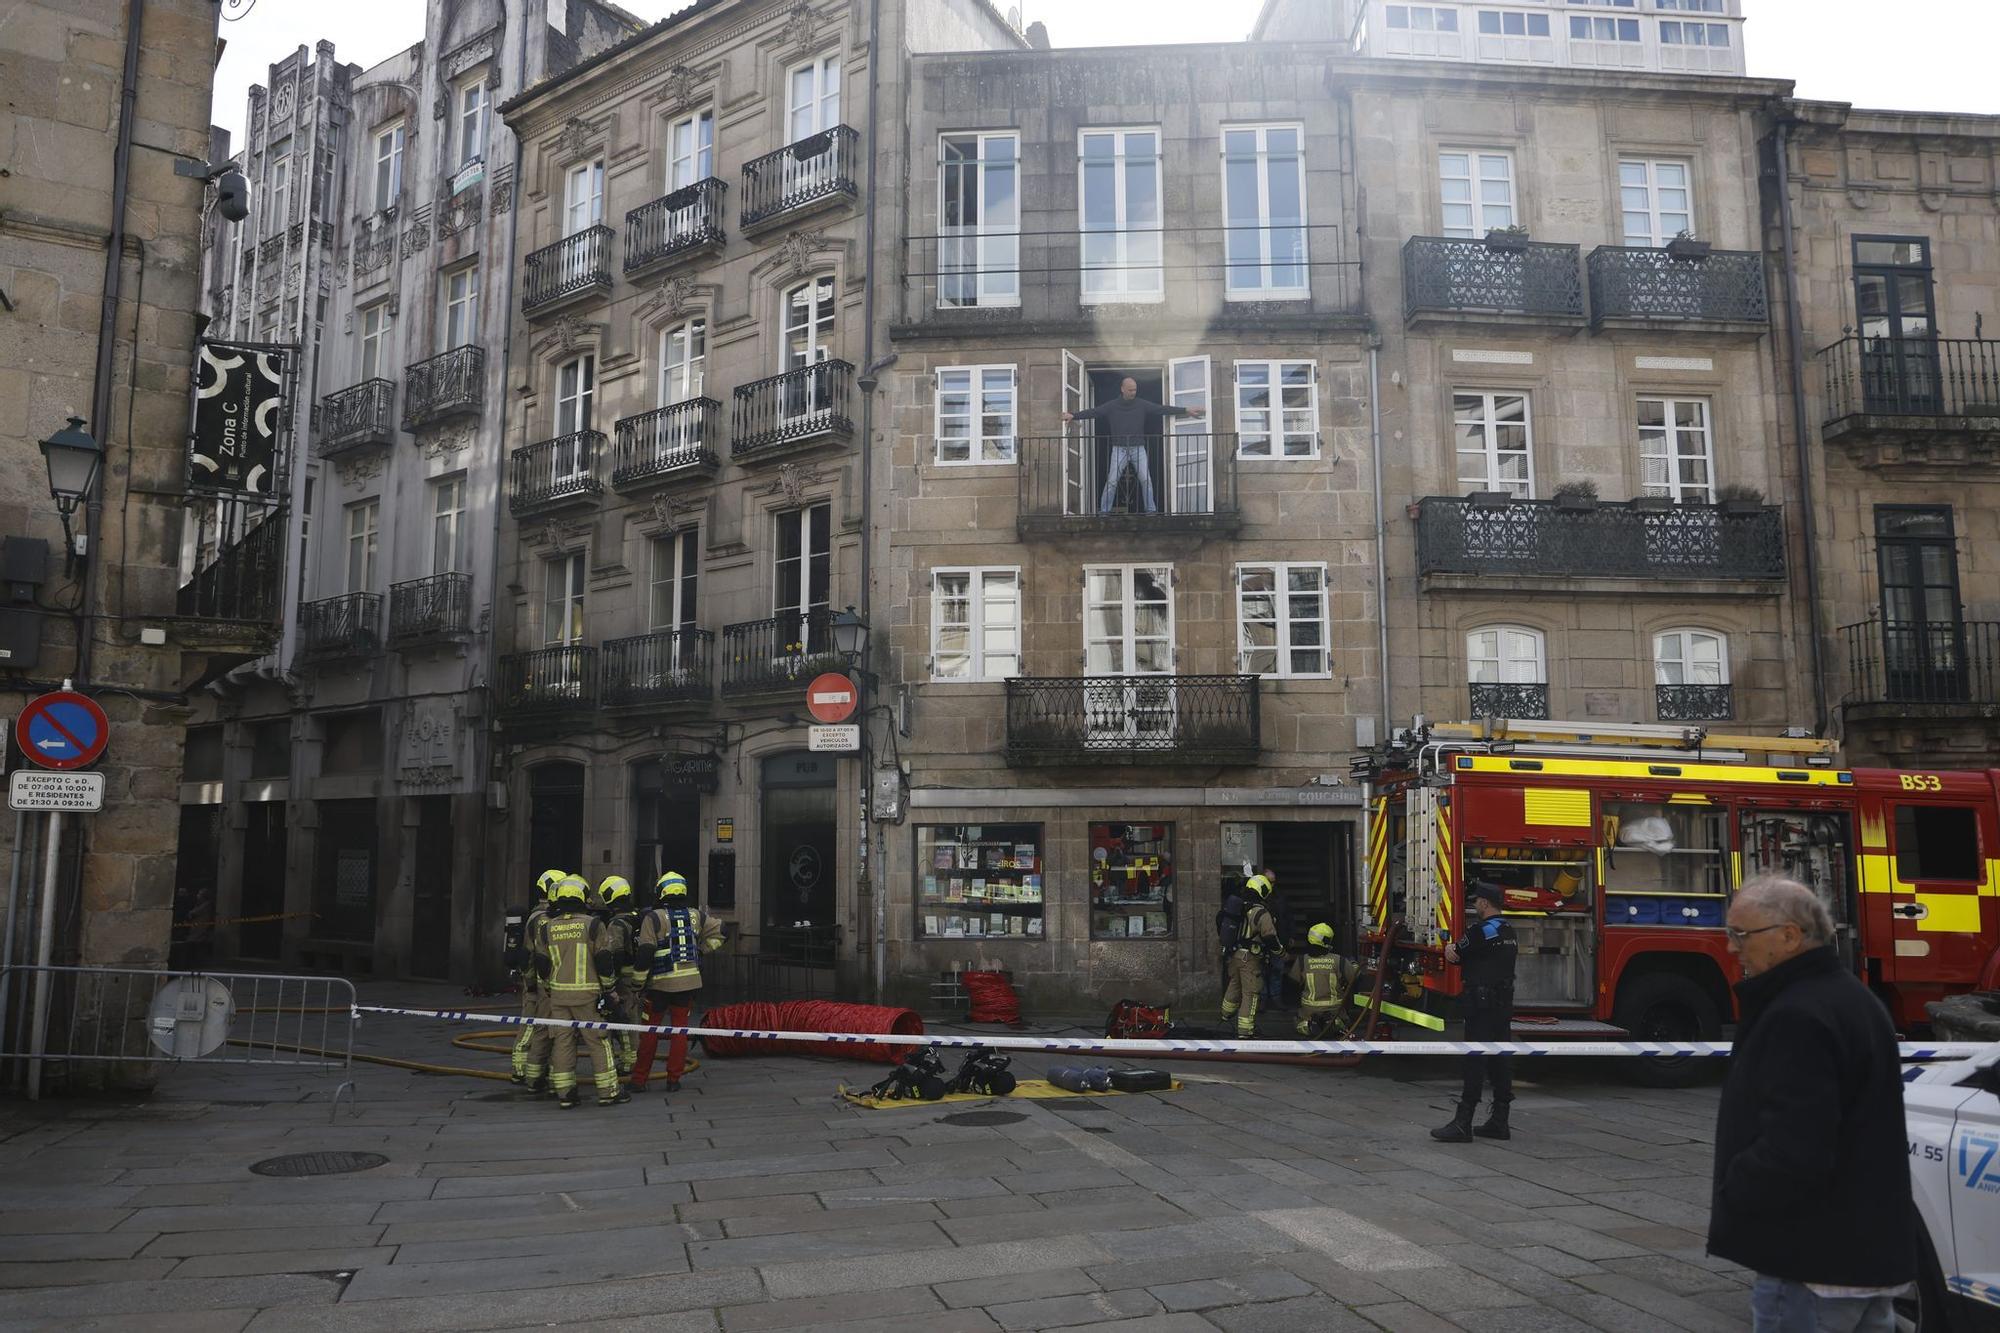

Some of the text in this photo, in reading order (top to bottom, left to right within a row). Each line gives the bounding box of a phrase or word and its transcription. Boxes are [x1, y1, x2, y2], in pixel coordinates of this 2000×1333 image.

[244, 372, 252, 395] cultural
[222, 402, 238, 414] C
[219, 418, 237, 456] Zona
[241, 431, 248, 440] de
[550, 923, 584, 932] BOMBEIROS
[552, 931, 581, 941] SANTIAGO
[1924, 1144, 1943, 1162] 55
